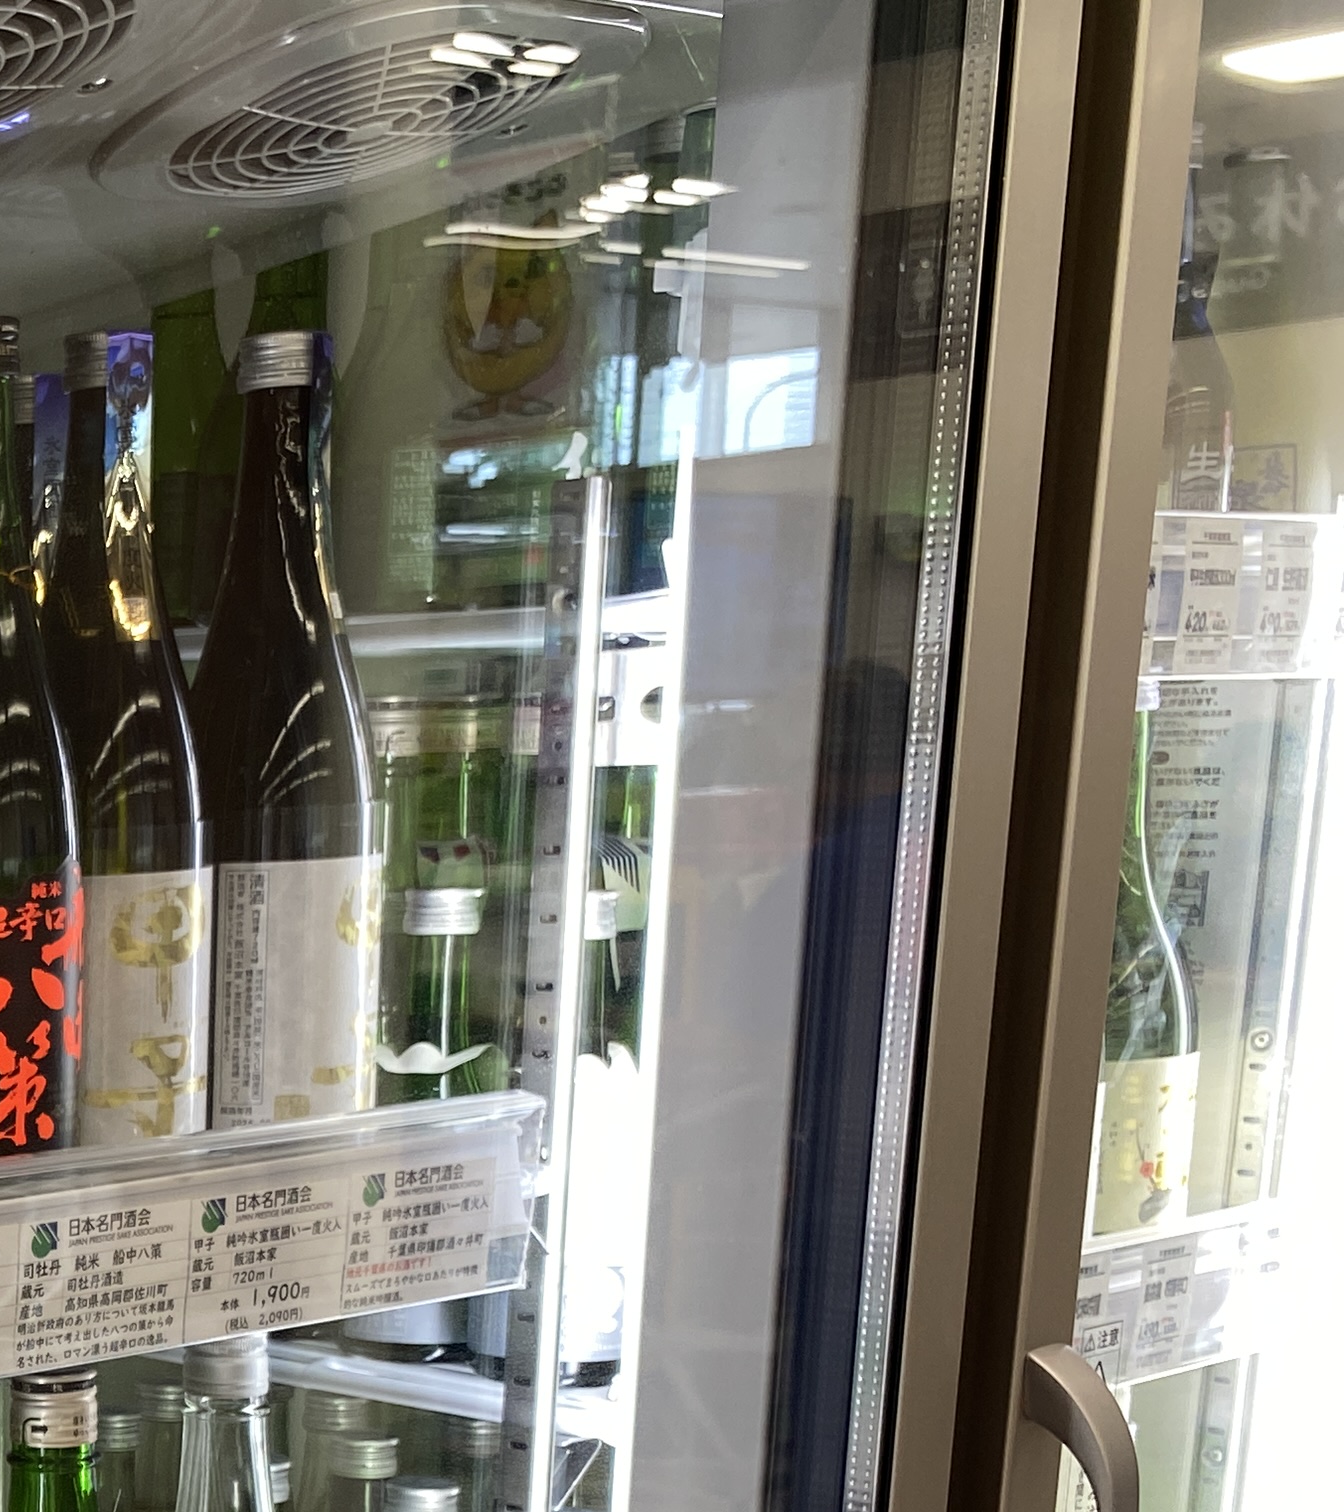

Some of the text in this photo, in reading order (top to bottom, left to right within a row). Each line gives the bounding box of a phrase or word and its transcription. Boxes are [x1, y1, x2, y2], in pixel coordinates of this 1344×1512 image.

[31, 881, 62, 900] 純米
[395, 1164, 464, 1188] 日本名門酒会
[236, 1186, 312, 1212] 日本名門酒会
[70, 1209, 151, 1236] 日本名門酒会
[23, 1244, 163, 1278] 司牡丹 純米 船中八策
[21, 1270, 124, 1299] 蔵元 司牡丹酒造
[220, 1281, 310, 1312] 本体 1,900円
[1097, 1328, 1119, 1349] 注意
